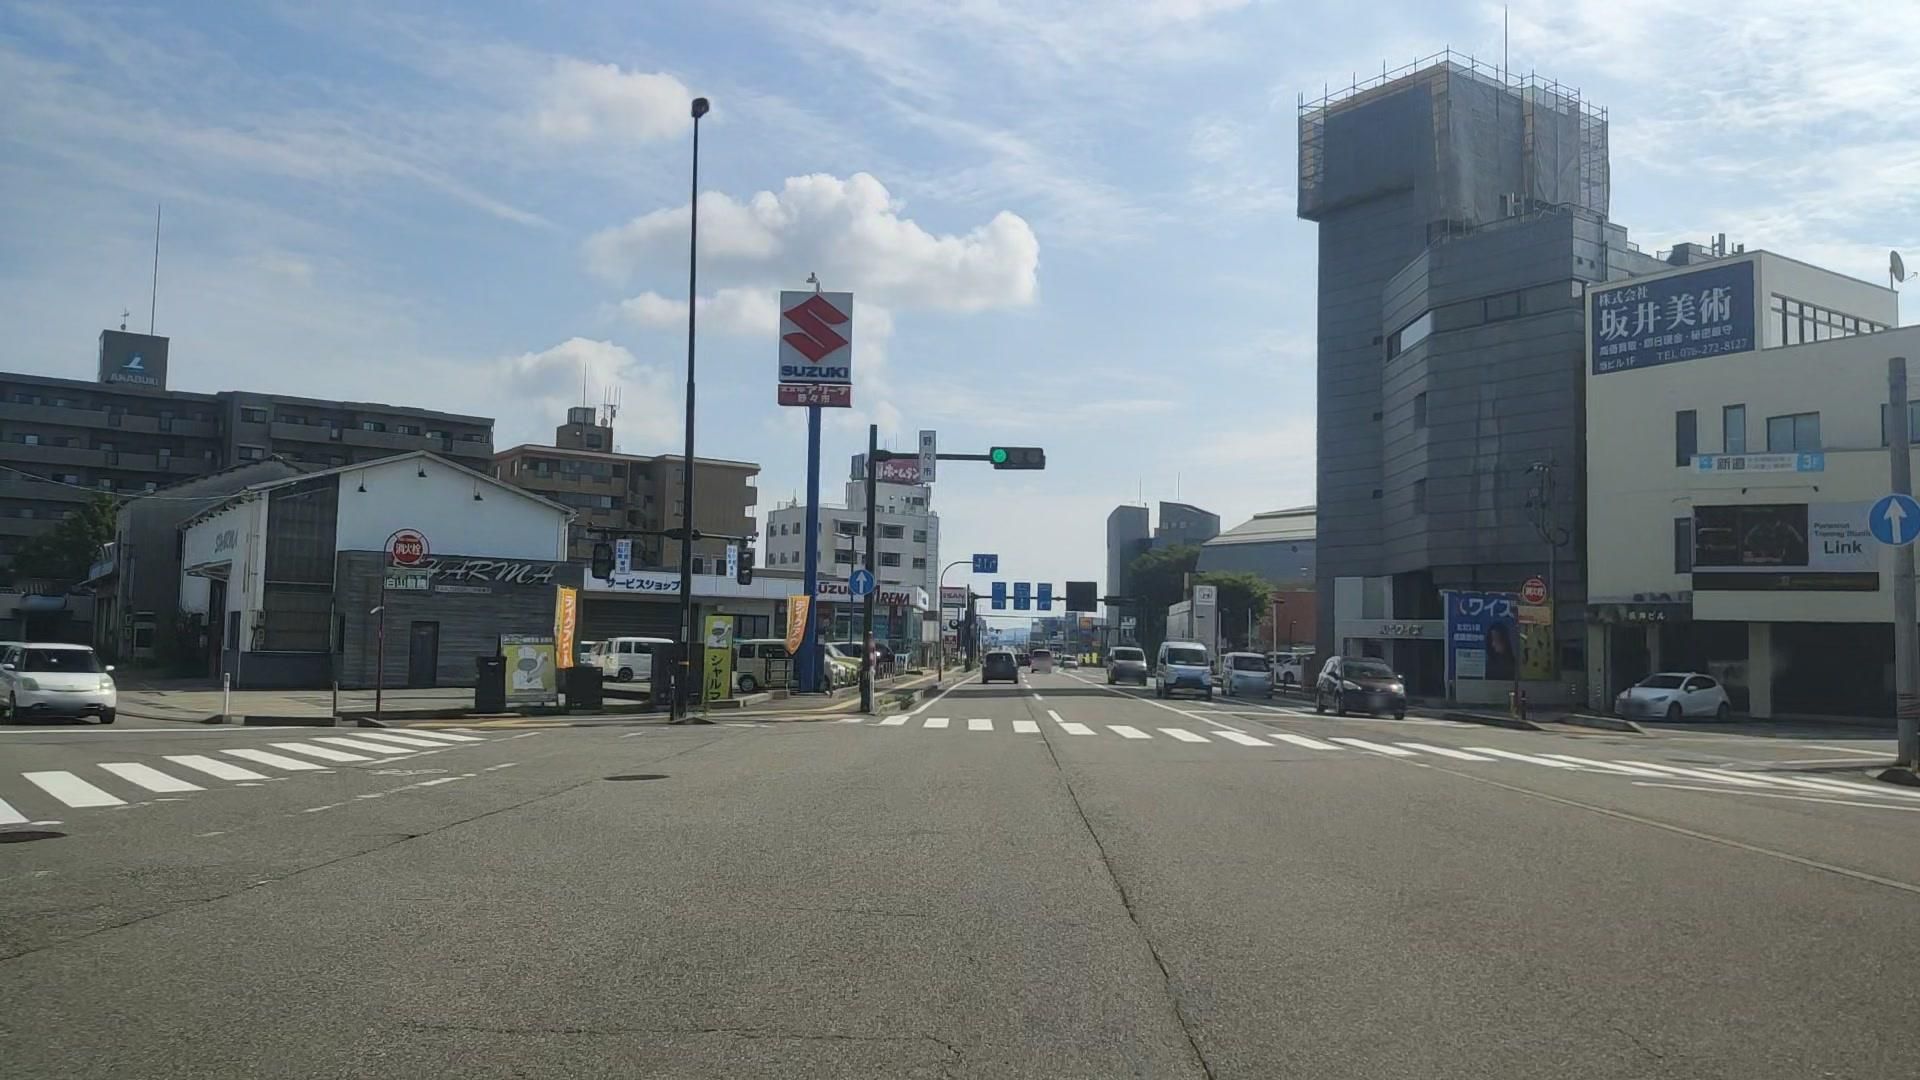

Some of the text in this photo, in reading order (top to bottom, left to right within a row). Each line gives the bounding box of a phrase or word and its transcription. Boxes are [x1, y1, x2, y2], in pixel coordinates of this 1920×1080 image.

[1599, 285, 1649, 307] 株式会社
[1599, 286, 1732, 341] 坂井美術
[781, 365, 849, 379] SUZUKI
[395, 542, 422, 556] 消火栓
[1824, 541, 1863, 554] Link
[606, 577, 681, 591] サービスショップ
